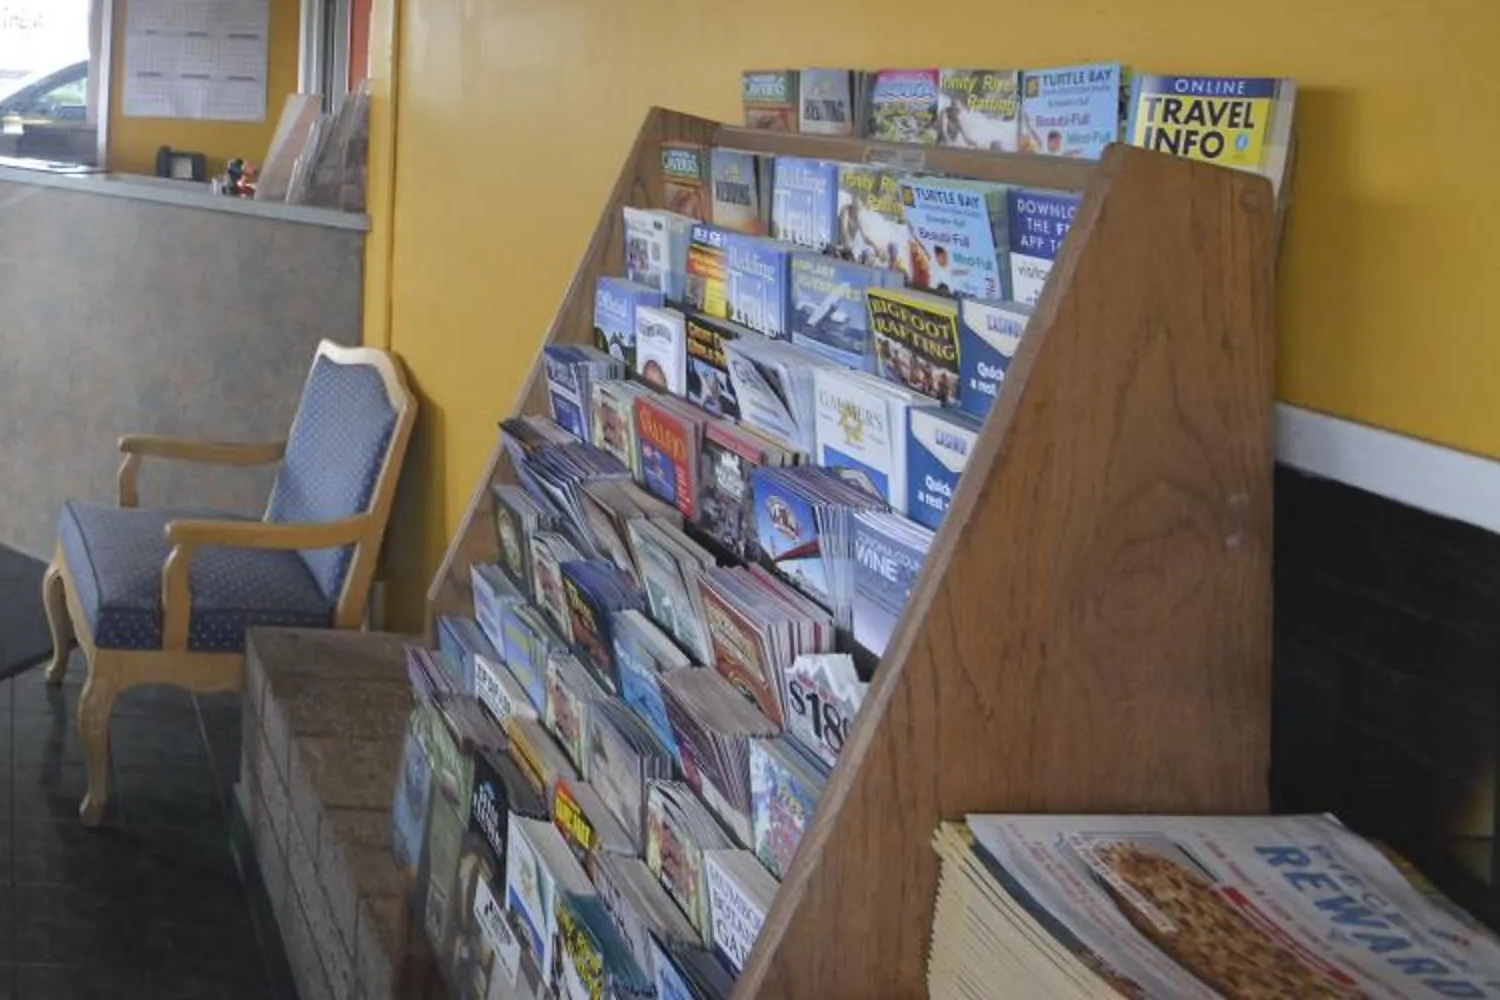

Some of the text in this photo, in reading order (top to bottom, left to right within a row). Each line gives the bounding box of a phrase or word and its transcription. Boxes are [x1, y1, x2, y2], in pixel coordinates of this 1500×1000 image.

[1043, 67, 1113, 87] TURTLE BAY
[1175, 79, 1246, 95] ONLINE
[1144, 97, 1255, 129] TRAVEL
[1143, 126, 1225, 159] INFO
[915, 187, 980, 210] TURTLE BAY
[1017, 198, 1077, 219] DOWNLO
[1027, 217, 1051, 234] THE
[1020, 235, 1044, 249] APP
[871, 298, 950, 338] BIGFOOT
[876, 316, 955, 360] RAFTING
